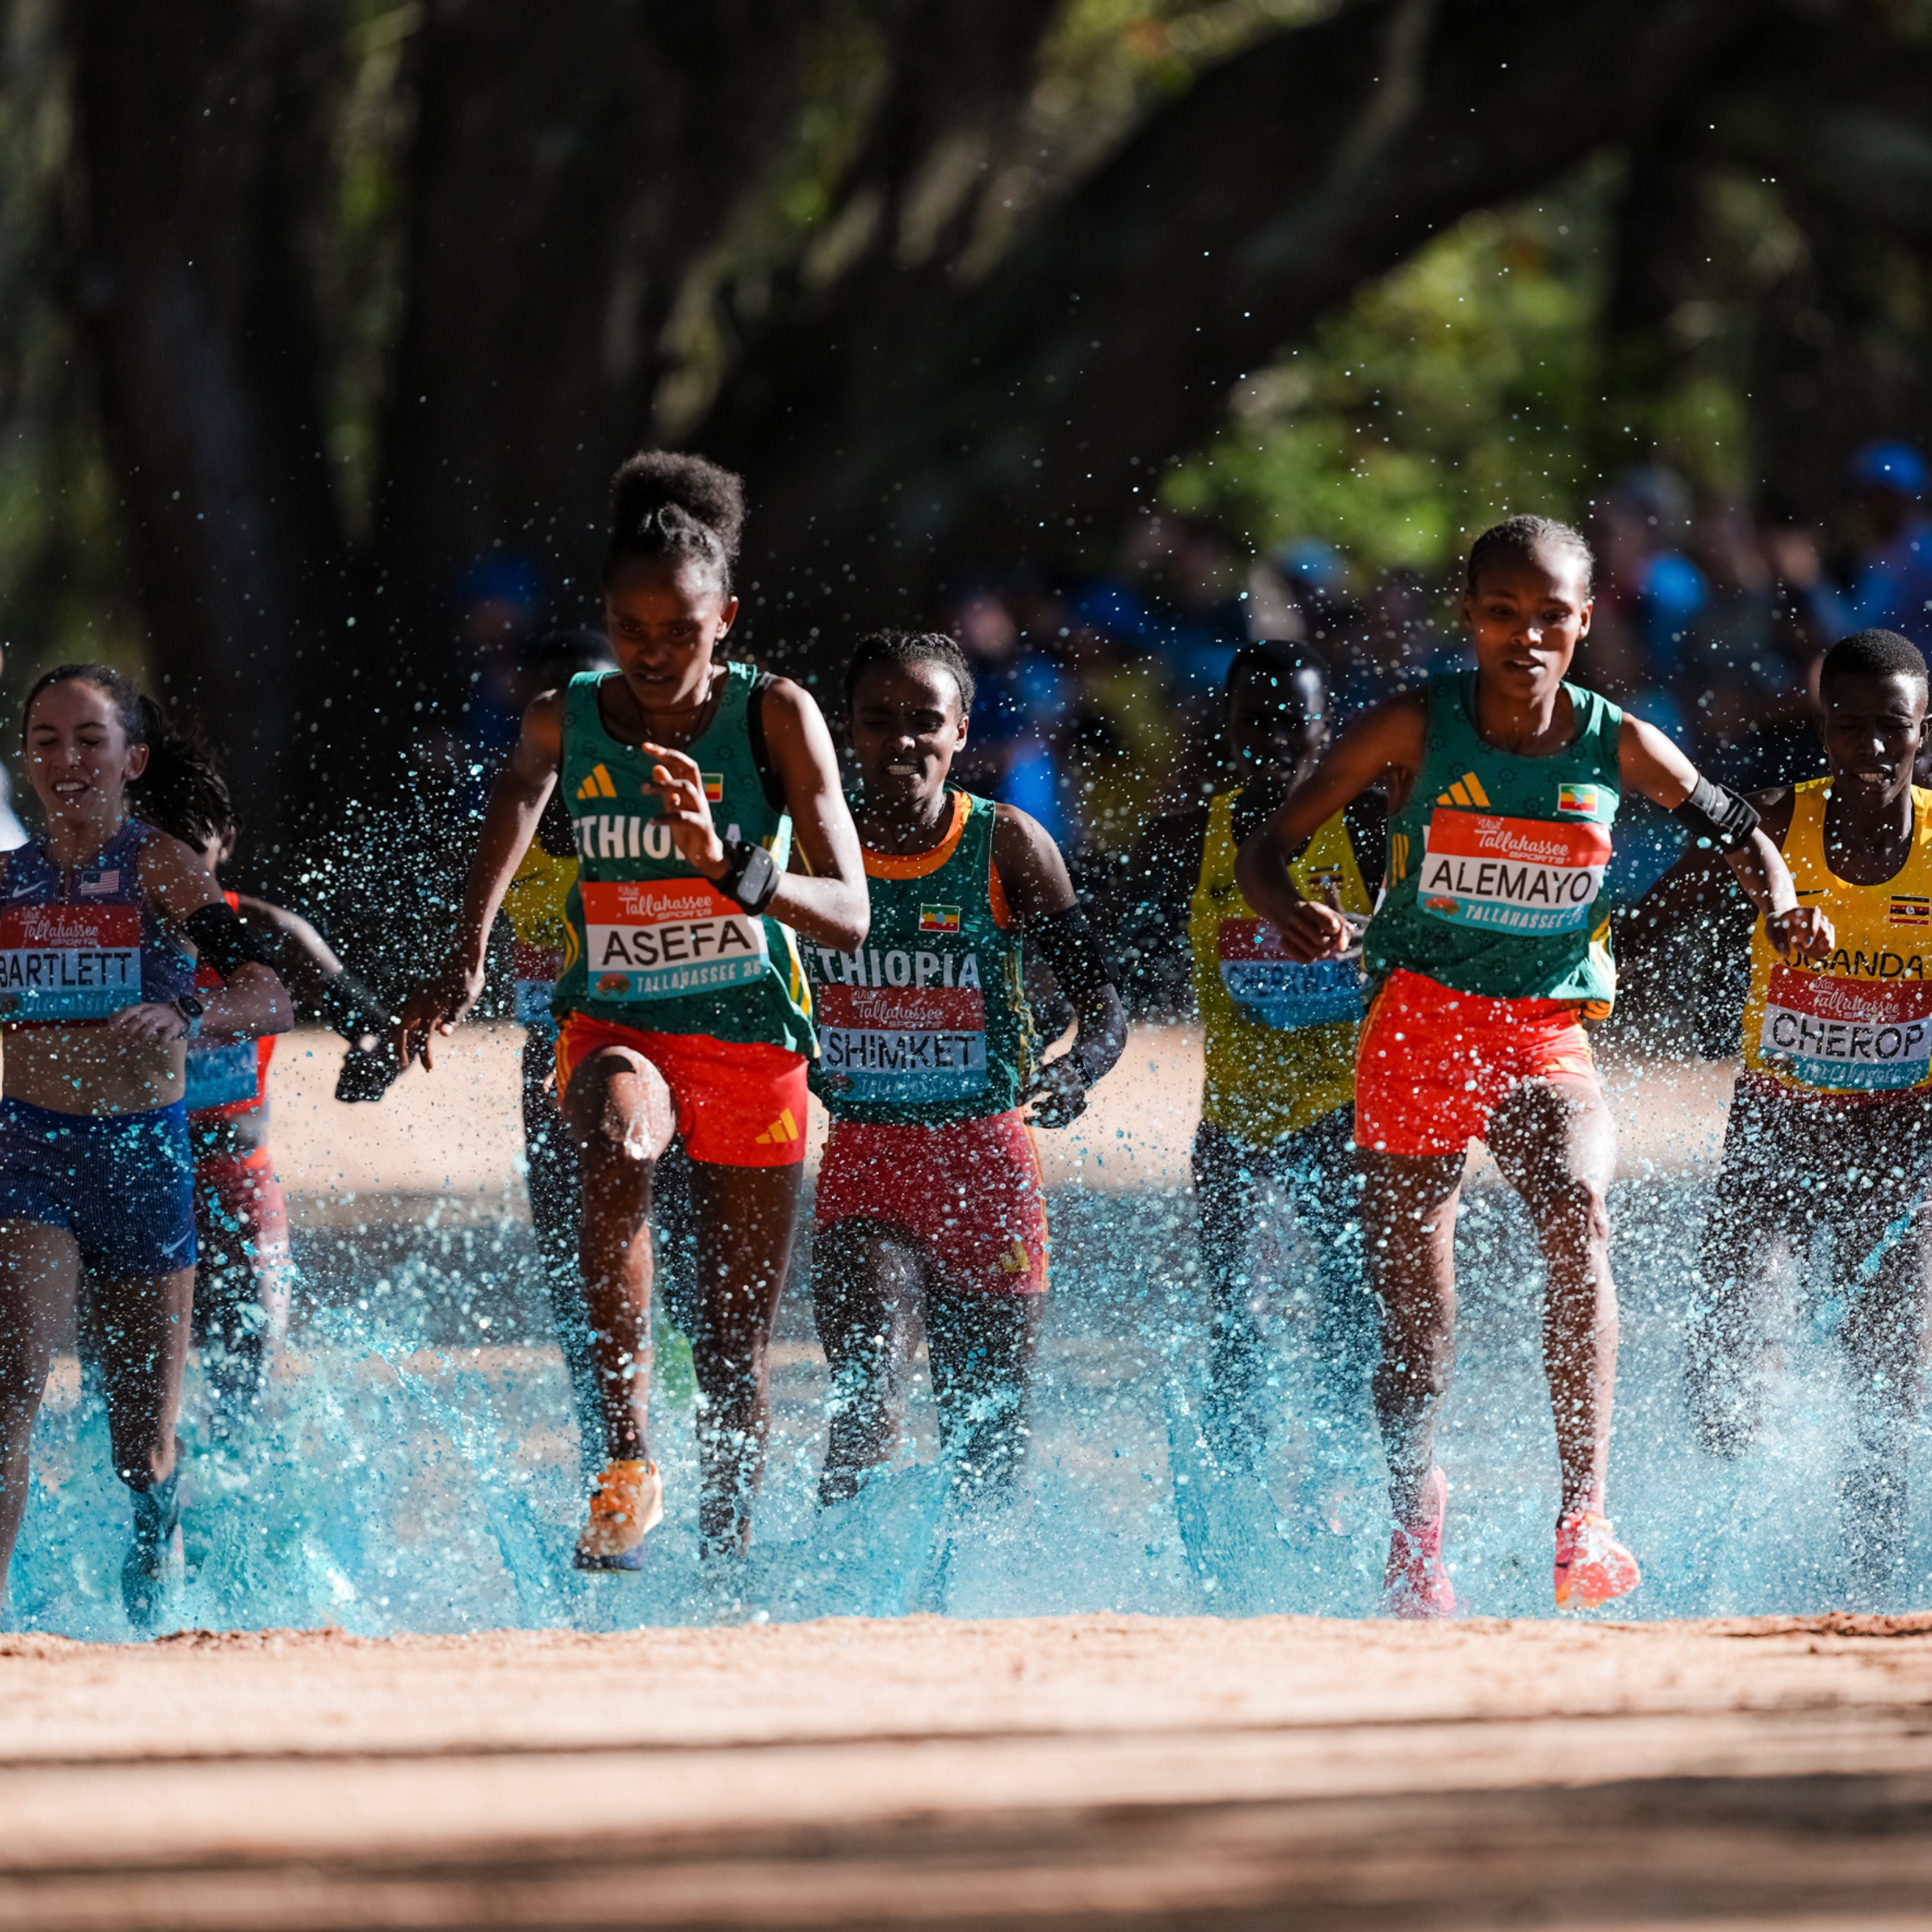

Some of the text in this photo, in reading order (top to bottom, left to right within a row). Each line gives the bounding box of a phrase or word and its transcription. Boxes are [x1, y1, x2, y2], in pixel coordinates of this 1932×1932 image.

[1478, 818, 1502, 829] Visit
[1474, 829, 1569, 855] Tallahassee
[1428, 859, 1593, 904] ALEMAYO
[618, 894, 713, 916] Tallahassee
[657, 909, 712, 920] SPORTS
[1466, 905, 1564, 929] TALLAHASSEE
[19, 920, 99, 941] Tallahassee
[602, 920, 752, 966] ASEFA
[638, 961, 762, 993] TALLAHASSEE 26
[855, 999, 943, 1023] Tallahassee
[1810, 989, 1900, 1014] Tallahassee
[1773, 1013, 1924, 1059] CHEROP
[826, 1032, 976, 1069] SHIMKET
